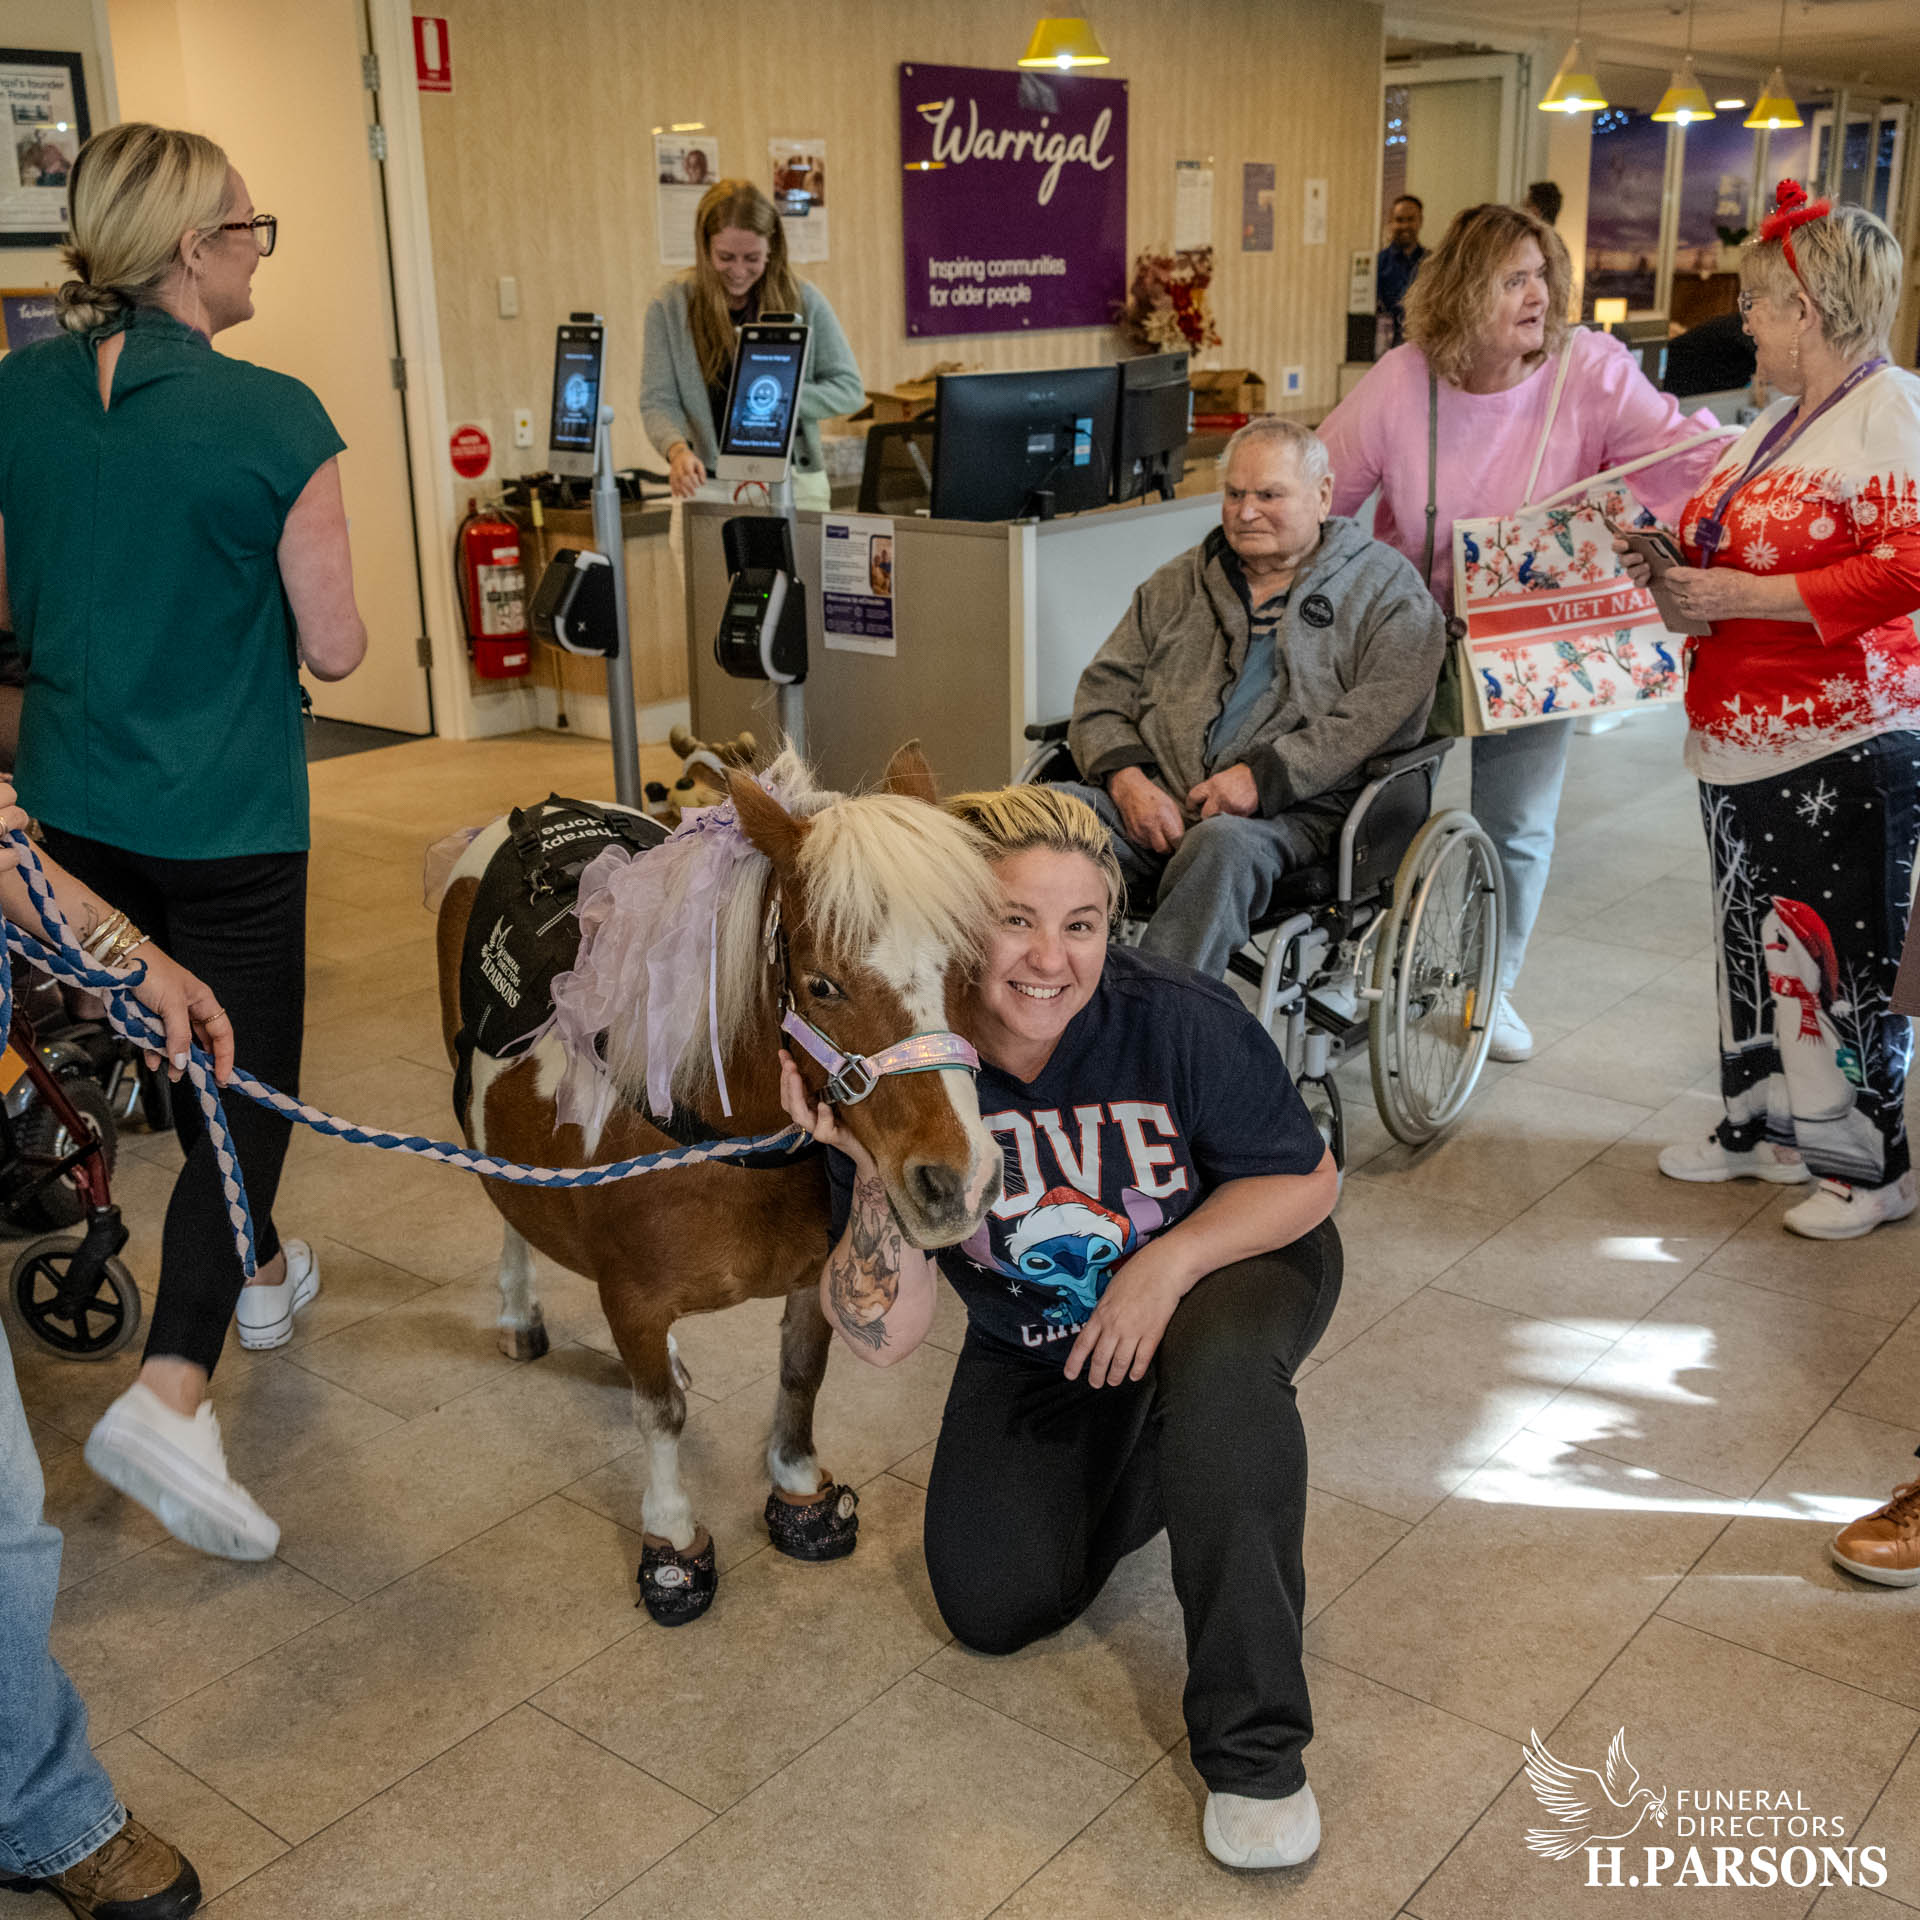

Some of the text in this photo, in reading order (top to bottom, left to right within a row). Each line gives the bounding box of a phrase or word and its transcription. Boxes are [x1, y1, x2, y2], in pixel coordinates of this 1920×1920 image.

[918, 97, 1115, 206] Warrigal
[928, 254, 1067, 284] Inspiring communities
[929, 282, 1032, 309] for older people
[1547, 598, 1604, 623] VIET
[982, 1099, 1189, 1222] OVE
